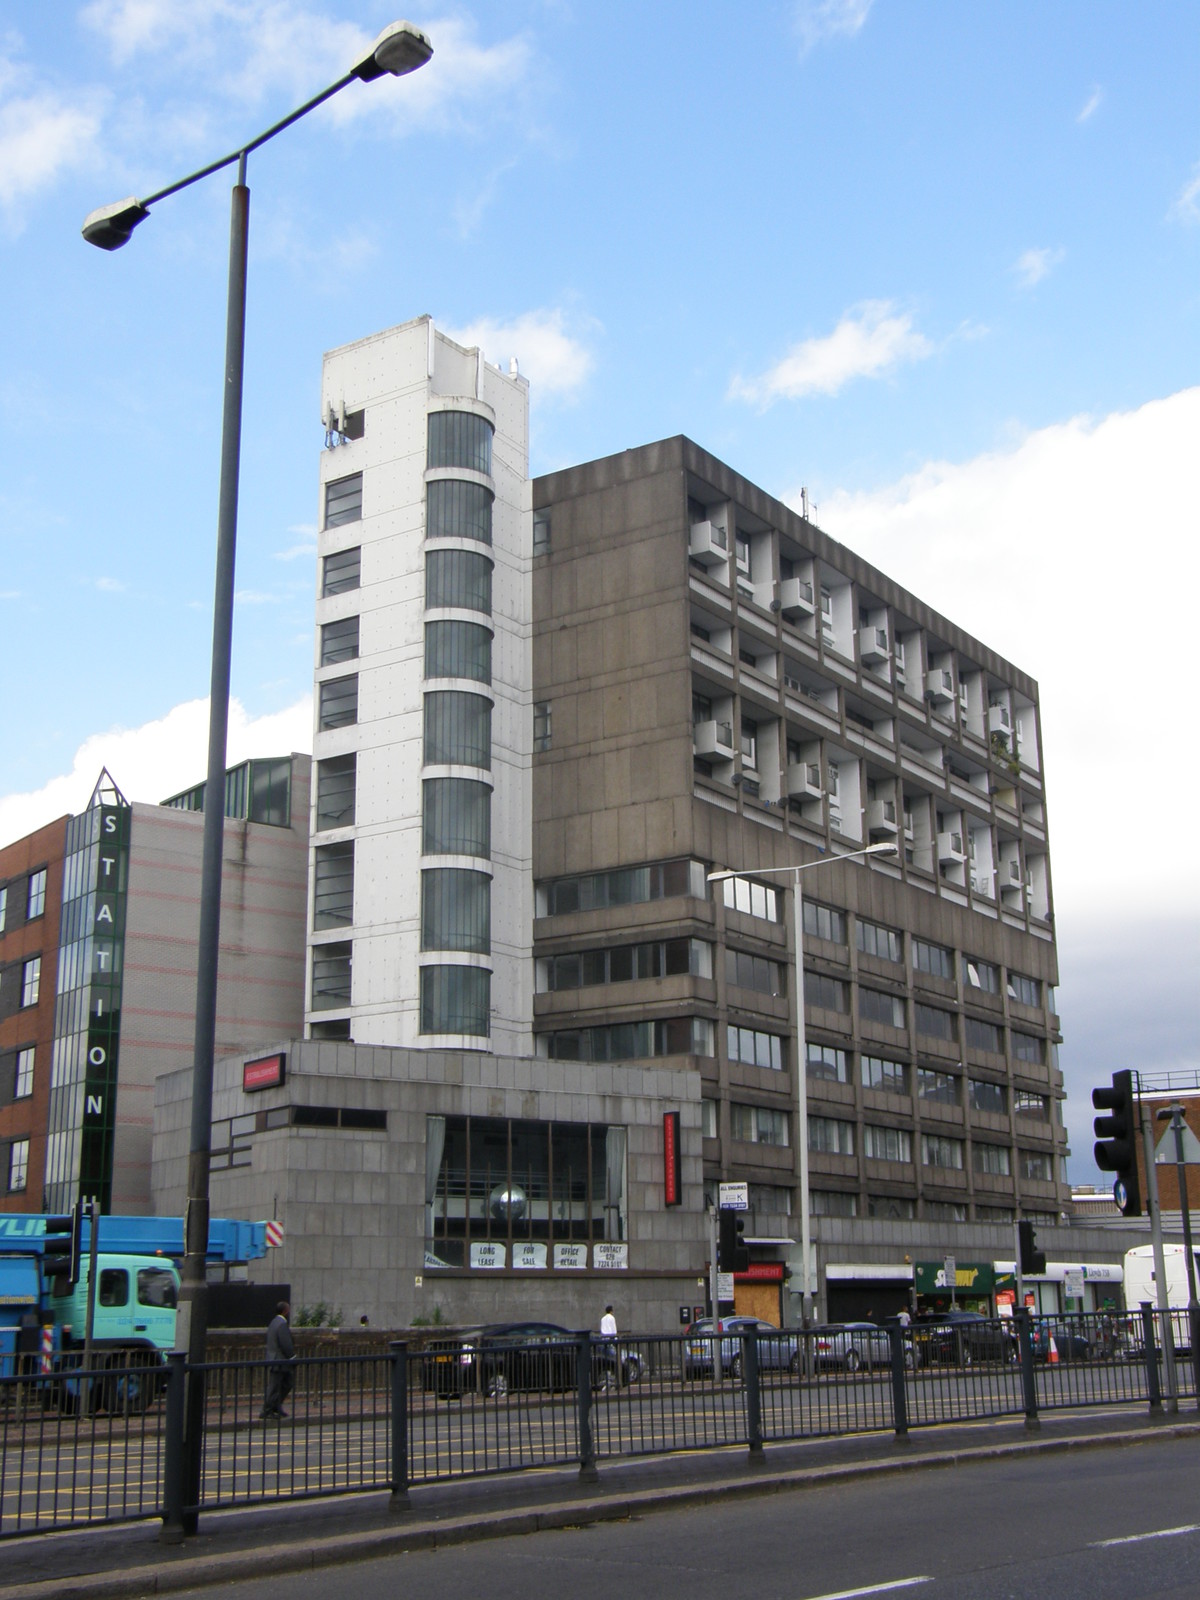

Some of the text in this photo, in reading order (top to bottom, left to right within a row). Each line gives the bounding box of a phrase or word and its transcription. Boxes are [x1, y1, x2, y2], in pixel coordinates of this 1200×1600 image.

[87, 815, 117, 1114] STATION
[480, 1246, 496, 1255] LONG
[523, 1246, 535, 1255] FOR
[561, 1247, 579, 1256] OFFICE
[600, 1245, 622, 1254] CONTACT
[478, 1258, 495, 1266] LEASE
[560, 1258, 578, 1267] RETAIL
[1088, 1267, 1102, 1279] Lloyds
